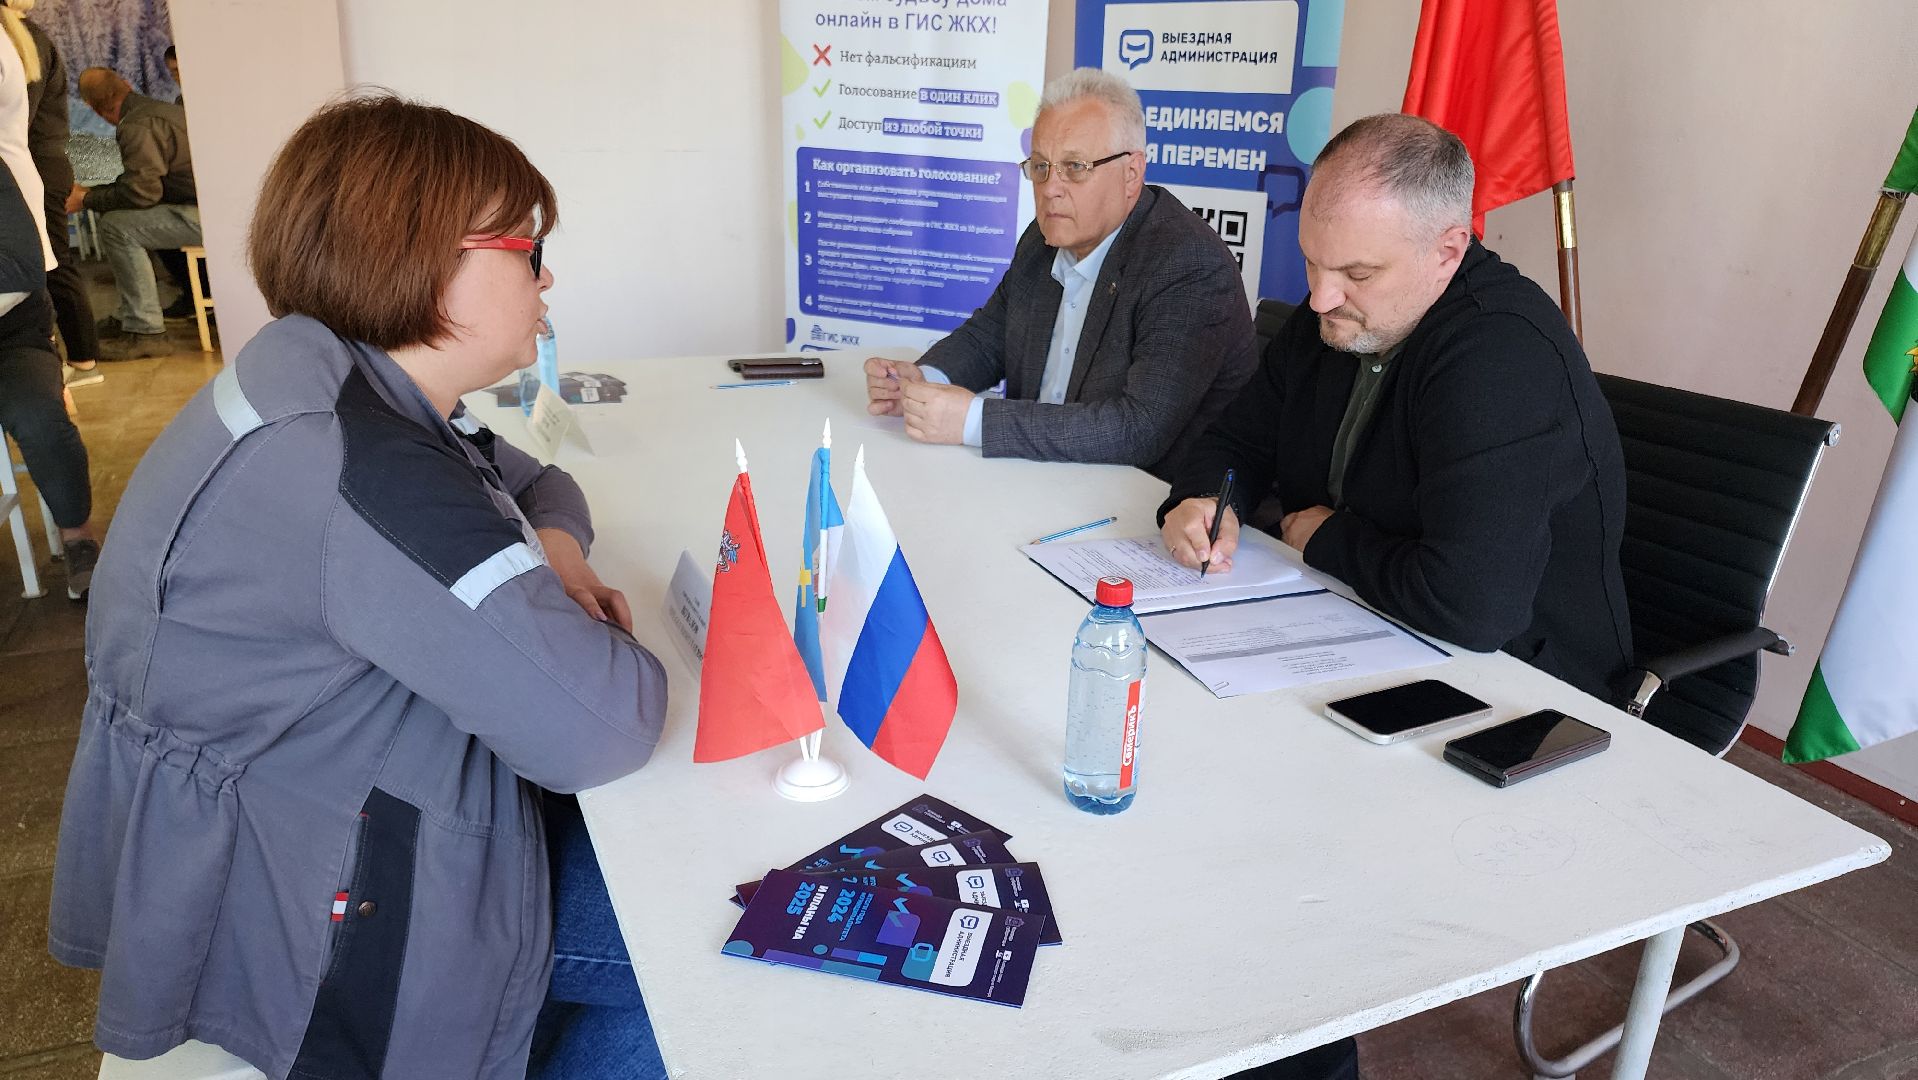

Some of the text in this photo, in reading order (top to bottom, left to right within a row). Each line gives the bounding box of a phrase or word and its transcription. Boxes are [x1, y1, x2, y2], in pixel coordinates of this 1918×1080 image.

[815, 11, 997, 34] онлайн в ГИС ЖКХ!
[1162, 32, 1232, 46] ВЫЕЗДНАЯ
[840, 51, 977, 70] Нет фальсификациям
[1160, 51, 1278, 65] АДМИНИСТРАЦИЯ
[838, 84, 998, 106] Голосование в один клик
[838, 117, 983, 139] Доступ из любой точки
[1146, 106, 1285, 134] ЕДИНЯЕМСЯ
[1162, 144, 1267, 172] ПЕРЕМЕН
[812, 158, 1001, 185] Как организовать голосование?
[804, 180, 811, 193] 1
[804, 212, 812, 224] 2
[804, 255, 813, 266] 3
[804, 295, 813, 307] 4
[786, 881, 816, 916] 2025
[818, 885, 829, 893] И
[800, 892, 825, 926] ПЛАНЫ
[827, 888, 856, 923] 2024
[792, 925, 808, 940] НА
